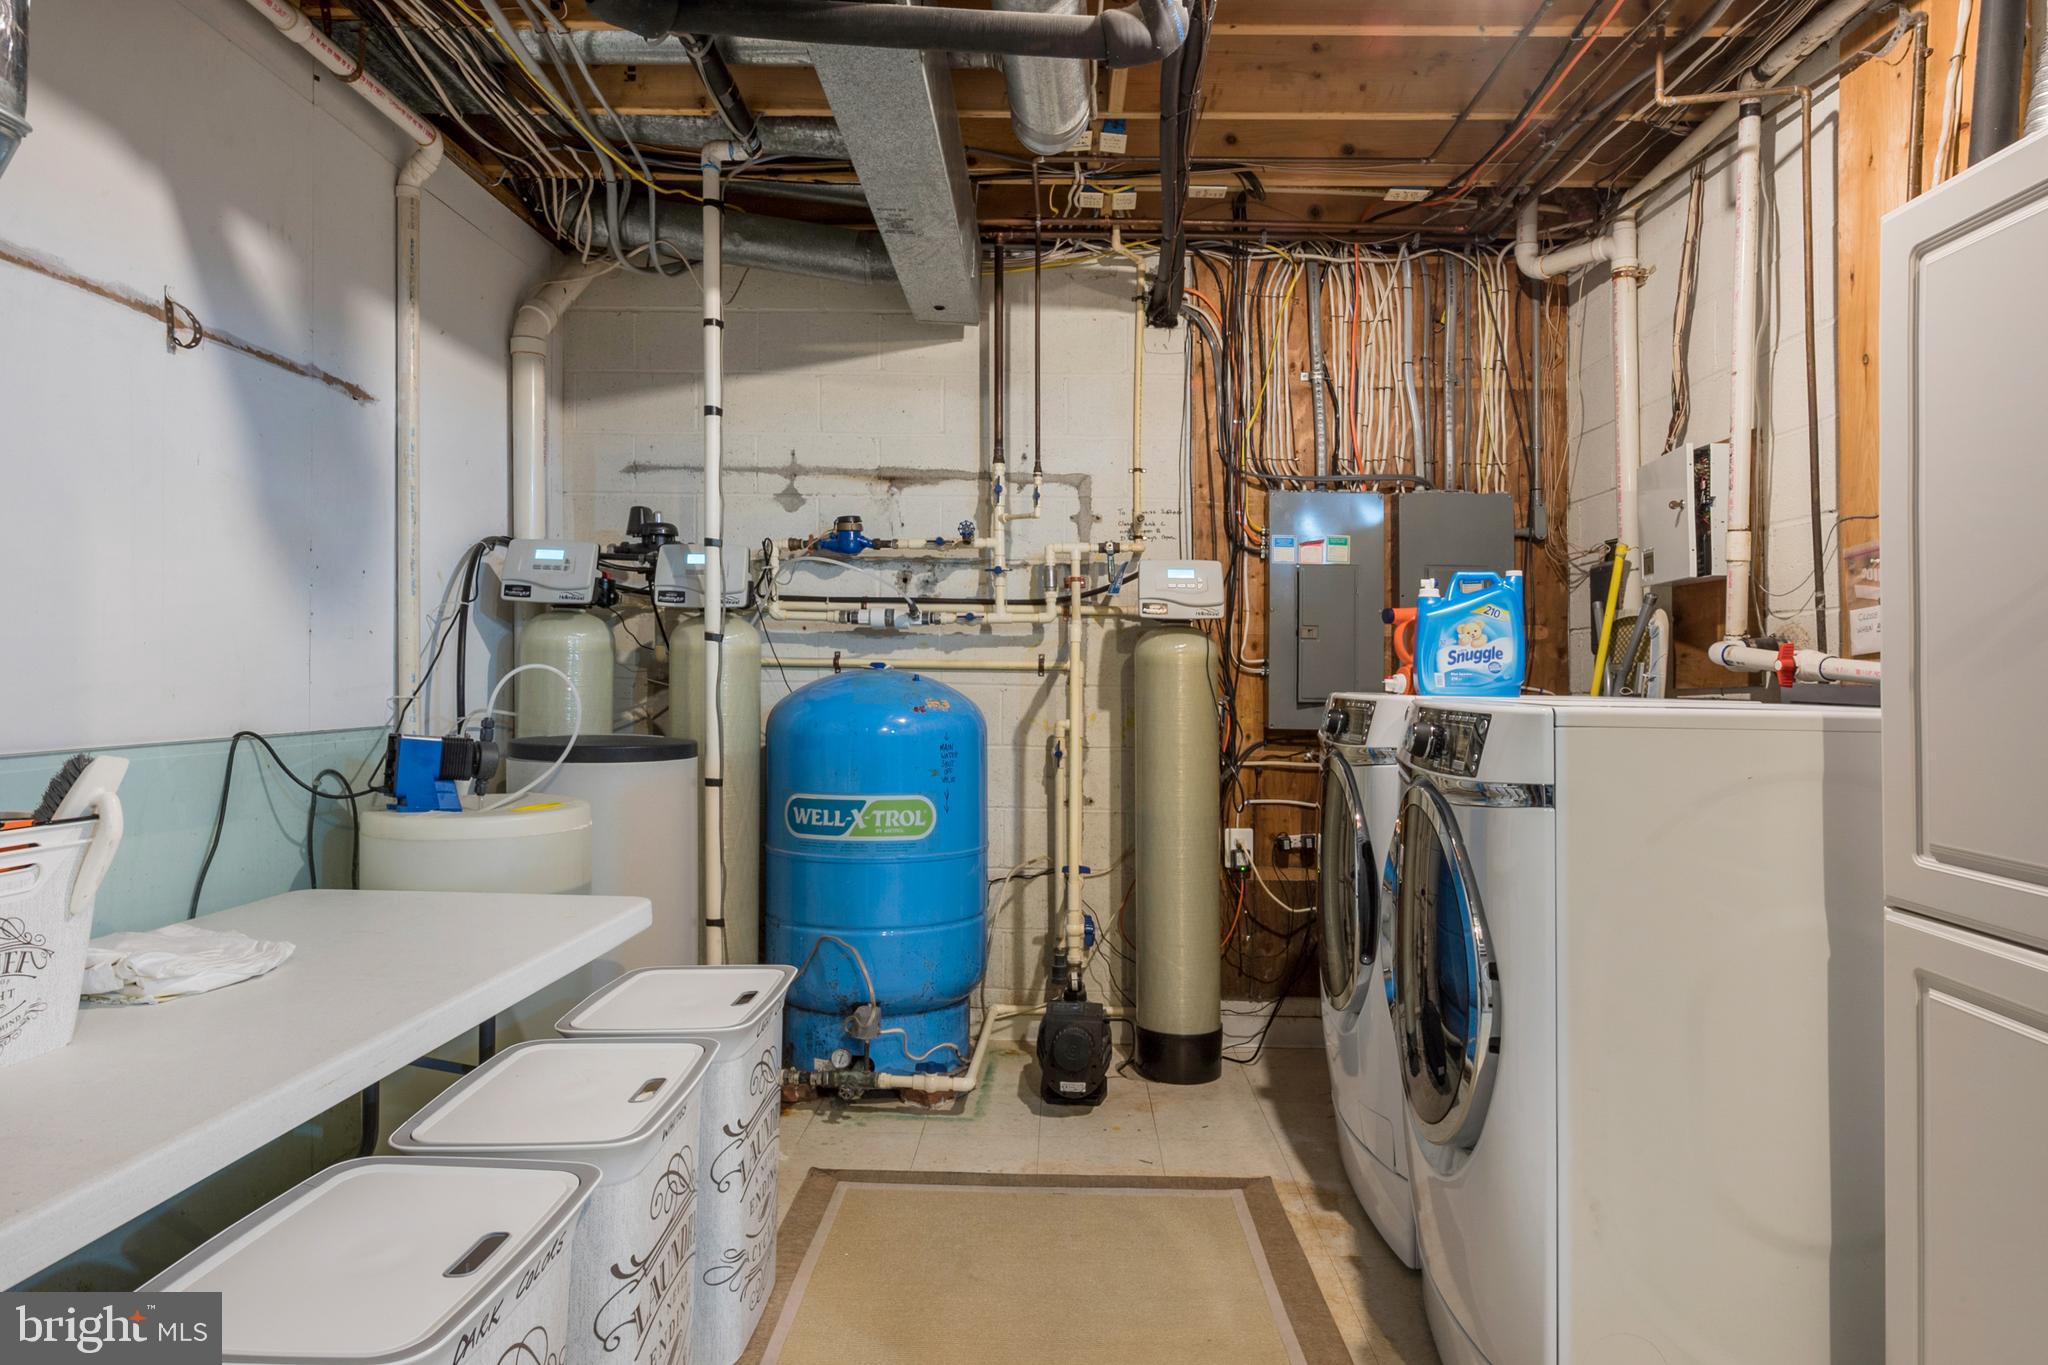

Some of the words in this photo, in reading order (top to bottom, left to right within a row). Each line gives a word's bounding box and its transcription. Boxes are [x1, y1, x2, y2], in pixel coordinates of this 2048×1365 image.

[1483, 605, 1501, 618] 210
[1447, 646, 1504, 666] Snuggle
[453, 1298, 504, 1365] DARK
